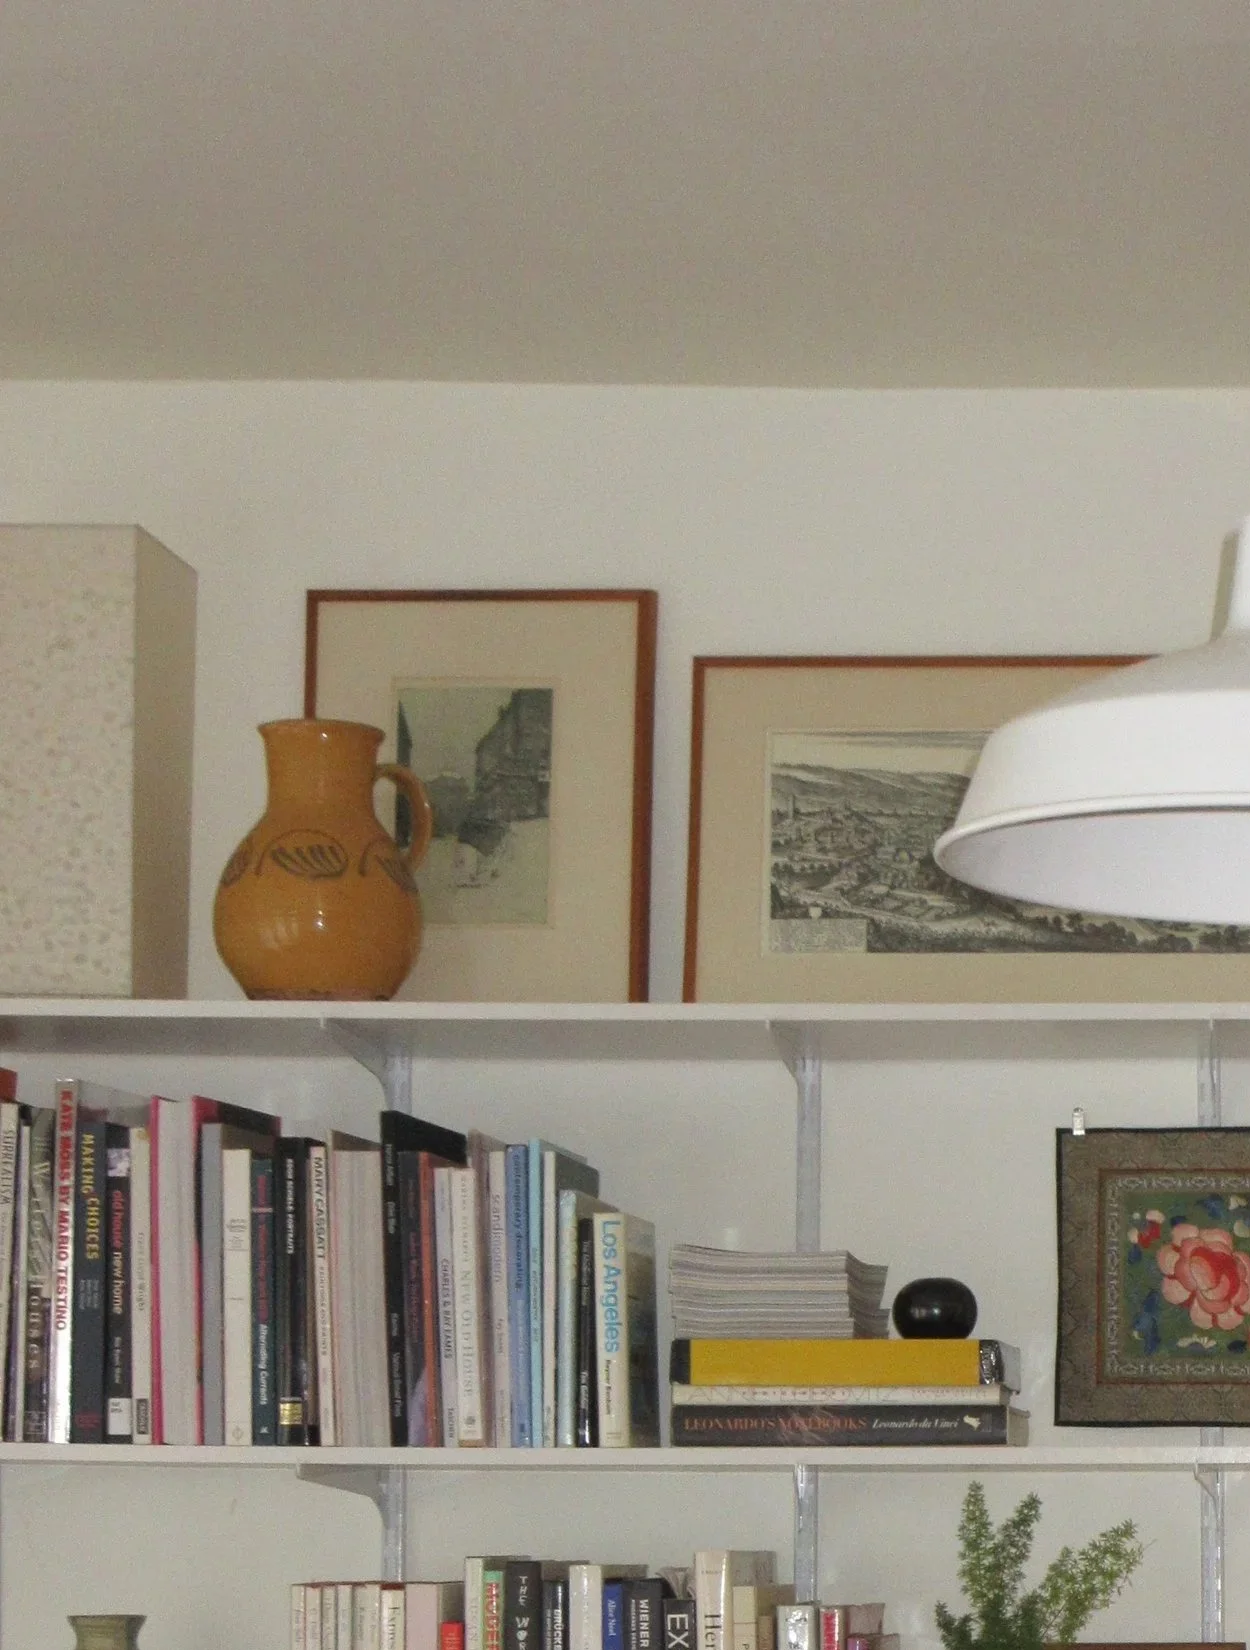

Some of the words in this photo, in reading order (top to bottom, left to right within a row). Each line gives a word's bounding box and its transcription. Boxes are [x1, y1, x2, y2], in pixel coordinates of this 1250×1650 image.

[59, 1089, 74, 1131] KATE
[59, 1135, 74, 1181] MOSS
[81, 1133, 97, 1195] MAKING
[313, 1157, 326, 1193] MARY
[58, 1185, 72, 1205] BY
[112, 1190, 125, 1210] old
[512, 1154, 524, 1230] contemporary
[56, 1210, 71, 1262] MARIO
[85, 1197, 101, 1260] CHOICES
[112, 1212, 125, 1249] house
[314, 1198, 327, 1261] CASSATT
[600, 1219, 622, 1261] Los
[112, 1251, 125, 1278] new
[440, 1257, 450, 1298] CHARLES
[54, 1266, 70, 1331] TESTINO
[112, 1279, 127, 1315] home
[600, 1264, 623, 1353] Angeles
[443, 1310, 453, 1328] RAY
[443, 1329, 454, 1359] EAMES
[462, 1346, 476, 1398] HOUSE
[607, 1599, 618, 1618] Alice
[639, 1598, 651, 1648] WIENER
